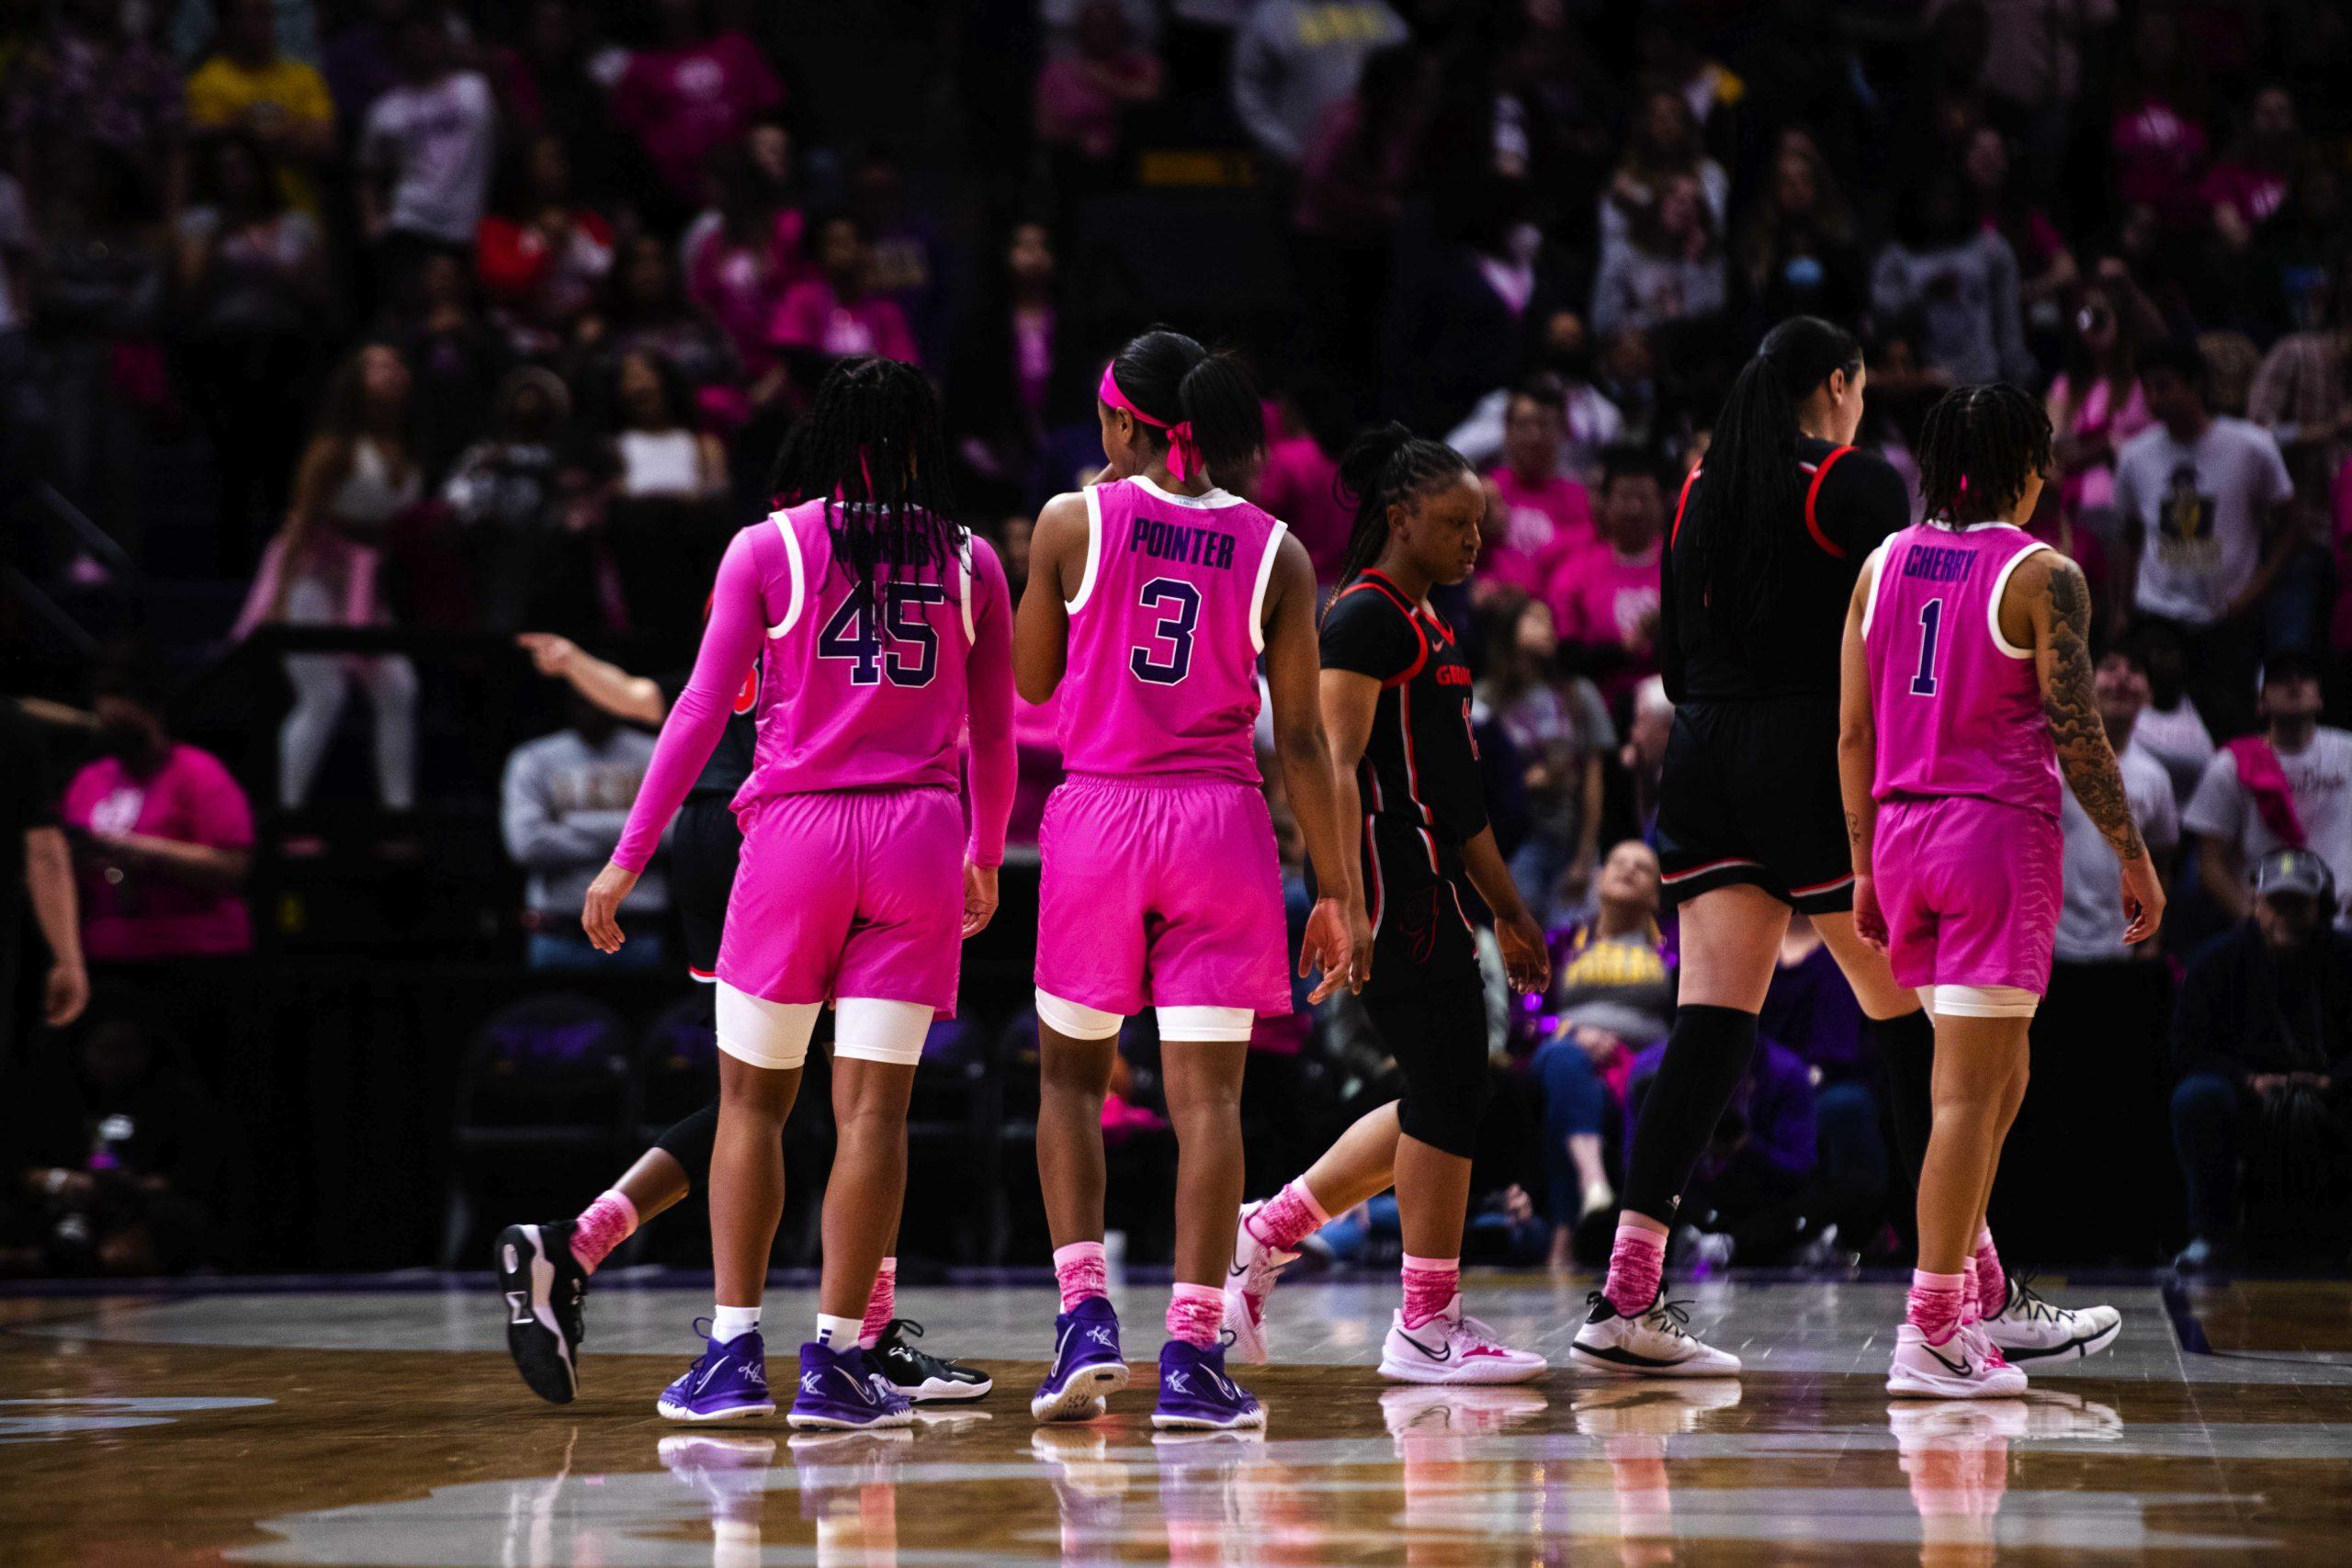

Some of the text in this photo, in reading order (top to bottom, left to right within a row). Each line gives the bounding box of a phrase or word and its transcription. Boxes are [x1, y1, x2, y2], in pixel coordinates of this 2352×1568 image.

[1130, 516, 1236, 570] POINTER
[1904, 544, 1979, 582] CHERRY
[817, 579, 944, 689] 45
[1128, 576, 1202, 686] 3
[1909, 598, 1943, 697] 1
